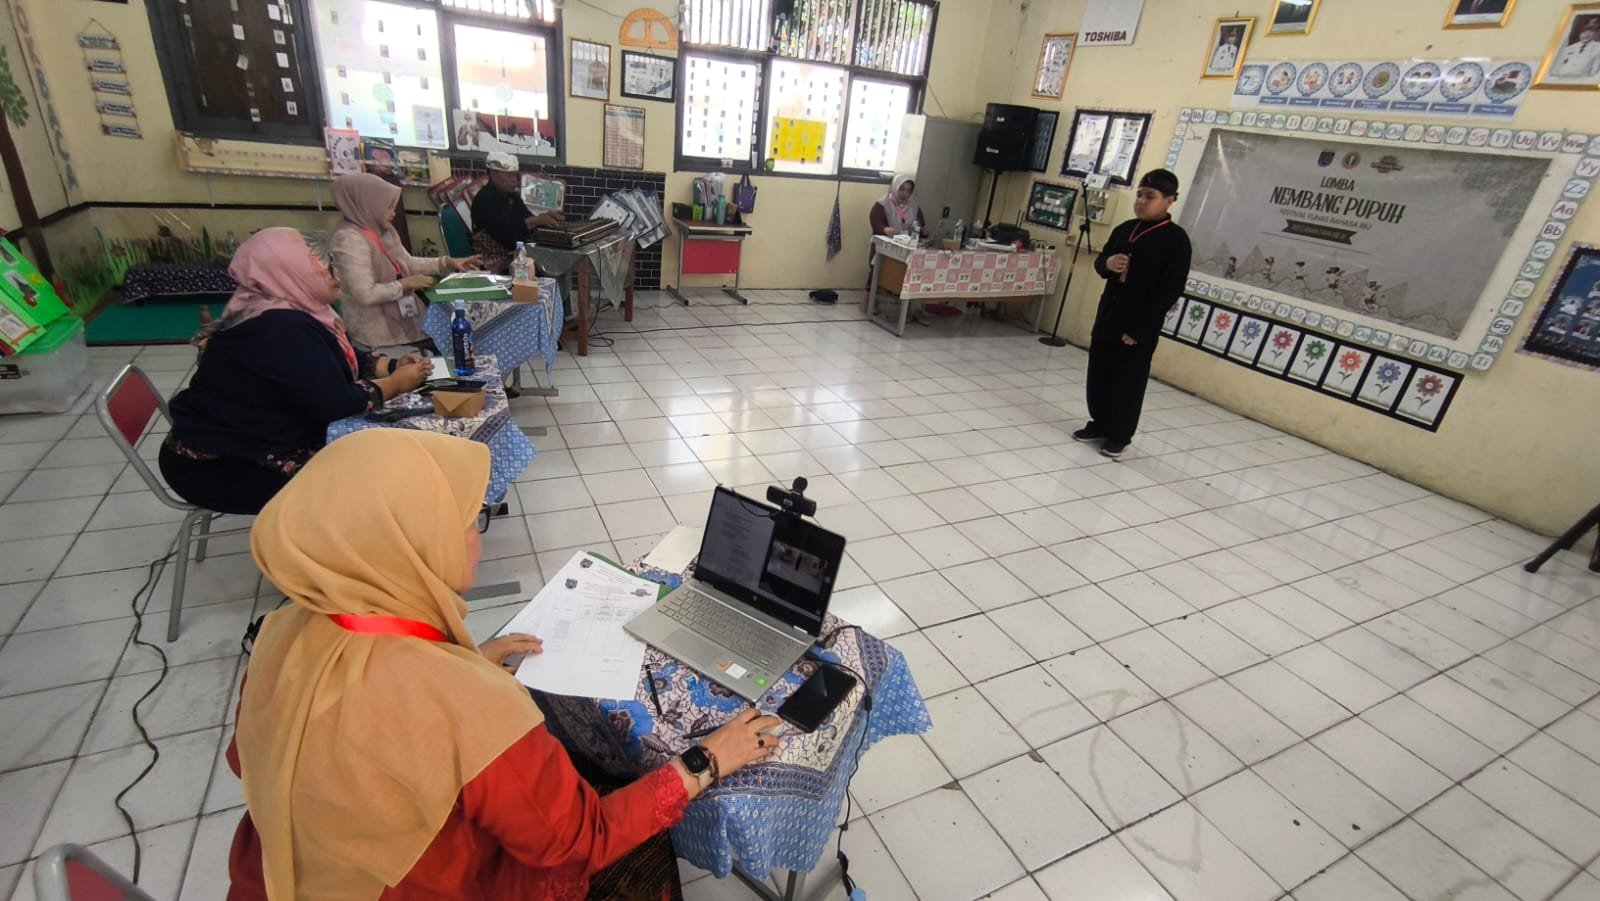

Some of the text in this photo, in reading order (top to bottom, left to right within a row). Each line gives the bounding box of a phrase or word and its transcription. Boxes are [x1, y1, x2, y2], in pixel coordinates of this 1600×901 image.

[1084, 31, 1127, 42] TOSHIBA
[1516, 136, 1532, 146] Uu
[1542, 136, 1559, 147] Vv
[1582, 161, 1599, 174] Yy
[1320, 176, 1355, 192] LOMBA
[1269, 186, 1407, 224] NEMBANG PUPUH
[1555, 204, 1575, 216] Aa
[1543, 224, 1562, 236] Bb
[1493, 319, 1511, 333] Gg
